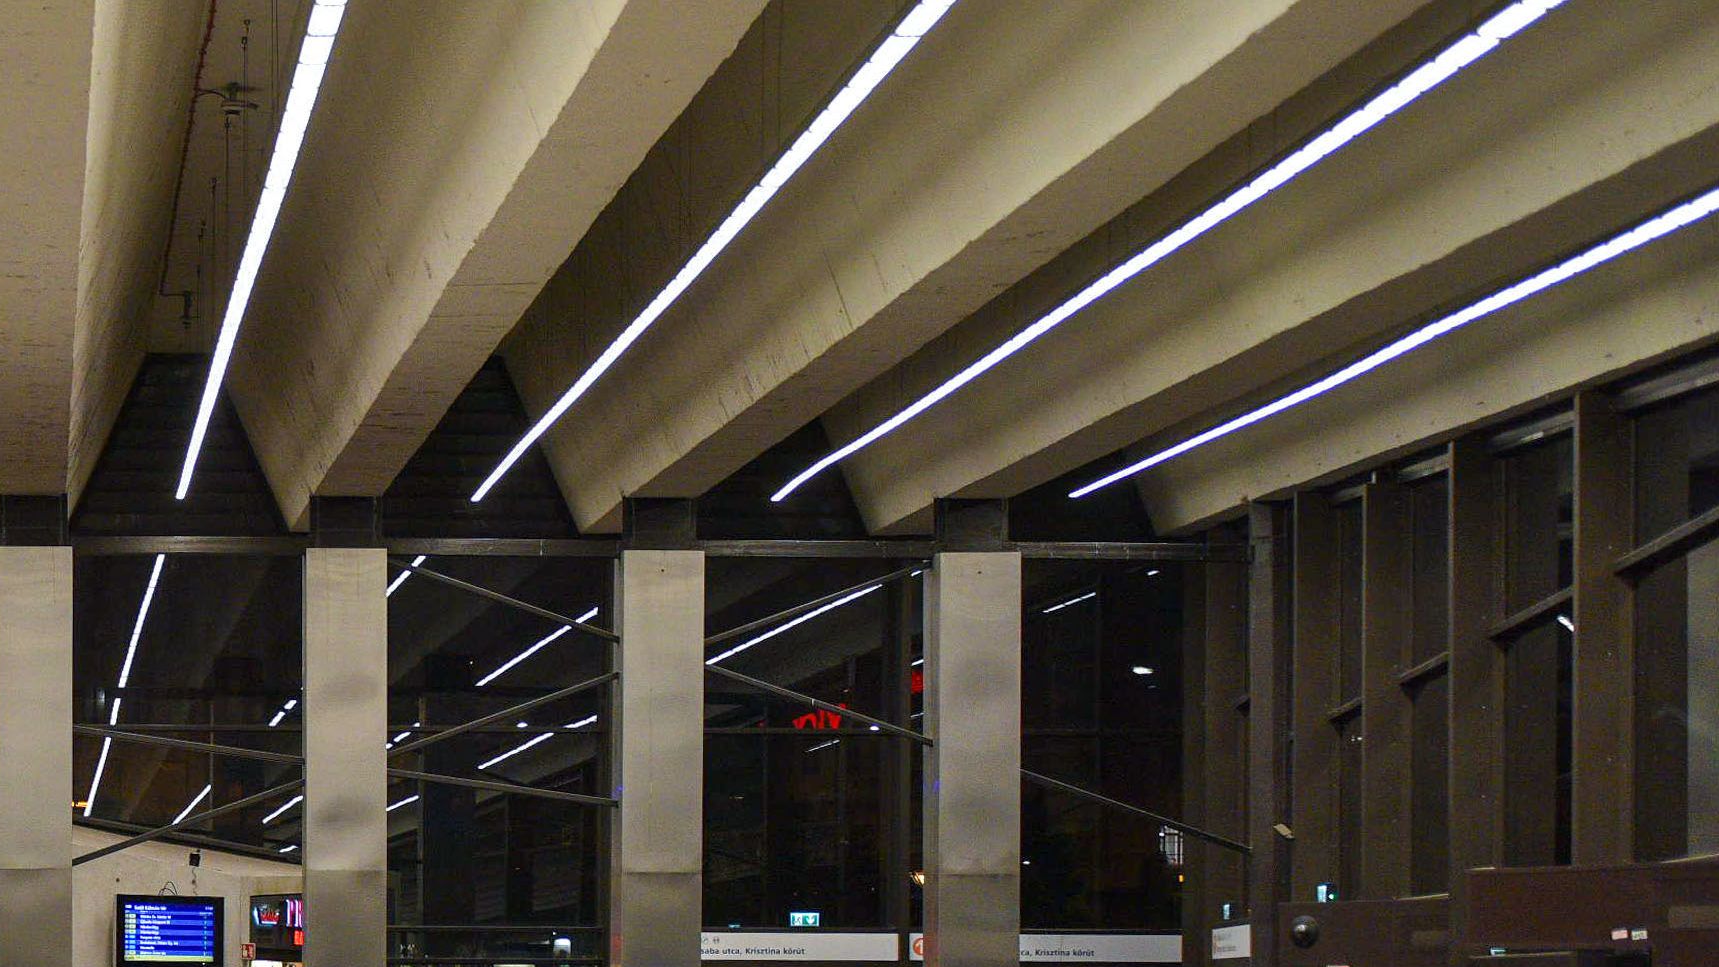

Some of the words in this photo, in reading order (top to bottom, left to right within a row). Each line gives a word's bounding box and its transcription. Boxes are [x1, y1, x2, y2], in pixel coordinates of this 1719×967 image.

[722, 948, 741, 956] utca,
[745, 947, 781, 955] Krisztina
[1035, 948, 1070, 956] Krisztina
